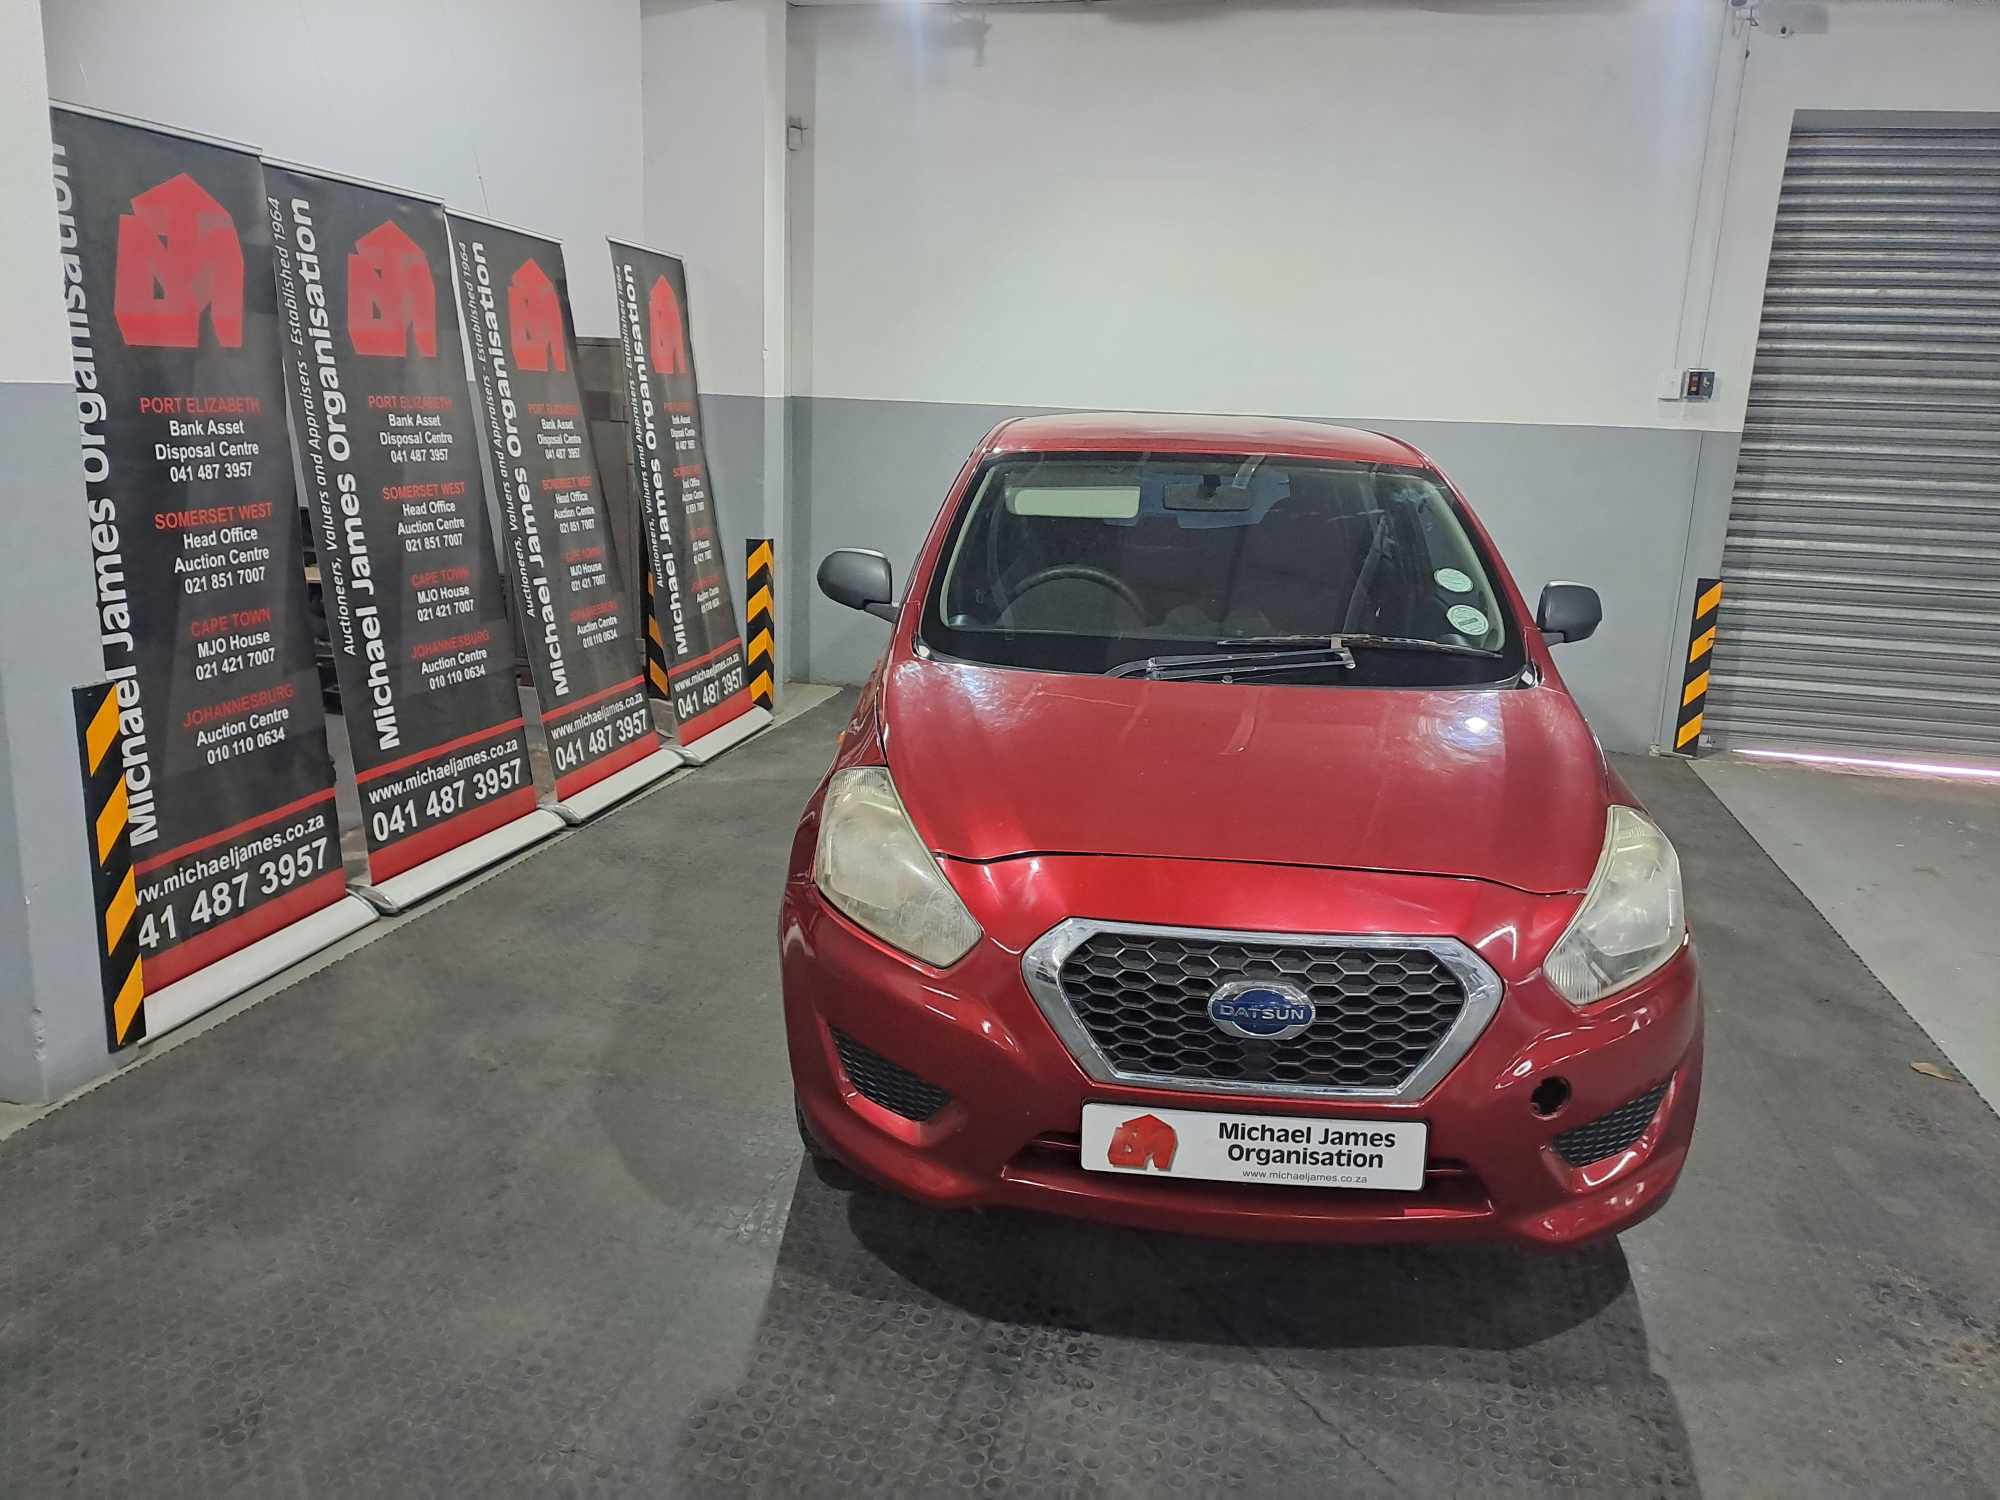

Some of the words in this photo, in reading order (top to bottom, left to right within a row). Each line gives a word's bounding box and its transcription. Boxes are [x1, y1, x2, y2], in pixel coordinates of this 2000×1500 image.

[268, 196, 286, 240] 1964
[274, 246, 304, 346] Established
[291, 198, 350, 462] Organisation
[464, 280, 487, 362] Established
[472, 241, 522, 458] Organisation
[623, 264, 656, 450] Organisation
[140, 397, 182, 414] PORT
[186, 396, 261, 414] ELIZABETH
[297, 360, 322, 450] Appraisers
[368, 395, 396, 409] PORT
[482, 374, 504, 448] Appraisers
[169, 420, 204, 436] Bank
[207, 419, 245, 436] Asset
[388, 414, 414, 427] Bank
[416, 414, 442, 426] Asset
[155, 442, 215, 463] Disposal
[219, 441, 260, 457] Centre
[380, 432, 423, 448] Disposal
[425, 431, 454, 444] Centre
[390, 450, 408, 464] 041
[410, 449, 427, 462] 487
[430, 448, 449, 461] 3957
[170, 466, 194, 482] 041
[197, 464, 220, 480] 487
[224, 462, 253, 478] 3957
[310, 453, 327, 486] and
[495, 450, 508, 478] and
[383, 484, 438, 500] SOMERSET
[441, 482, 465, 496] WEST
[402, 502, 427, 517] Head
[429, 500, 456, 514] Office
[502, 480, 519, 532] Valuers
[650, 458, 672, 546] James
[154, 506, 236, 530] SOMERSET
[239, 502, 273, 519] WEST
[319, 491, 338, 551] Valuers
[398, 521, 434, 536] Auction
[436, 517, 465, 531] Centre
[514, 467, 544, 568] James
[183, 531, 217, 549] Head
[220, 526, 258, 544] Office
[336, 473, 374, 596] James
[406, 538, 422, 552] 021
[424, 536, 441, 550] 851
[443, 534, 463, 547] 7007
[89, 498, 133, 651] James
[174, 553, 226, 574] Auction
[229, 547, 270, 564] Centre
[184, 575, 207, 594] 021
[211, 572, 234, 589] 851
[237, 567, 266, 584] 7007
[417, 589, 439, 604] MJO
[440, 586, 470, 600] House
[331, 557, 356, 656] Auctioneers,
[417, 608, 434, 622] 021
[436, 604, 452, 619] 421
[454, 599, 474, 615] 7007
[662, 552, 688, 656] Michael
[191, 616, 232, 637] CAPE
[232, 608, 272, 628] TOWN
[532, 577, 570, 697] Michael
[197, 639, 227, 658] MJO
[230, 631, 270, 650] House
[421, 656, 457, 676] Auction
[458, 648, 488, 665] Centre
[195, 662, 218, 680] 021
[221, 656, 244, 674] 421
[247, 648, 276, 668] 7007
[355, 605, 401, 751] Michael
[429, 676, 446, 690] 010
[448, 670, 463, 686] 110
[464, 664, 486, 680] 0634
[183, 684, 294, 728] JOHANNESBURG
[678, 690, 700, 718] 041
[702, 680, 720, 706] 487
[722, 667, 742, 695] 3957
[197, 721, 246, 747] Auction
[249, 708, 289, 730] Centre
[551, 692, 643, 740] www.michaeljames.co.za
[105, 665, 159, 847] Michael
[206, 745, 230, 765] 010
[232, 738, 254, 757] 110
[256, 727, 286, 748] 0634
[556, 738, 584, 770] 041
[588, 724, 612, 754] 487
[616, 708, 647, 742] 3957
[368, 739, 518, 804] www.michaeljames.co.za
[372, 800, 418, 842] 041
[426, 780, 465, 818] 487
[472, 758, 521, 800] 3957
[136, 814, 325, 906] w.michaeljames.co.za
[138, 904, 177, 949] 41
[190, 871, 249, 924] 487
[259, 836, 328, 895] 3957
[1220, 1004, 1304, 1020] DATSUN
[1218, 1122, 1312, 1144] Michael
[1318, 1128, 1396, 1148] James
[1227, 1144, 1384, 1168] Organisation
[1242, 1170, 1368, 1184] www.michaeljames.co.za
